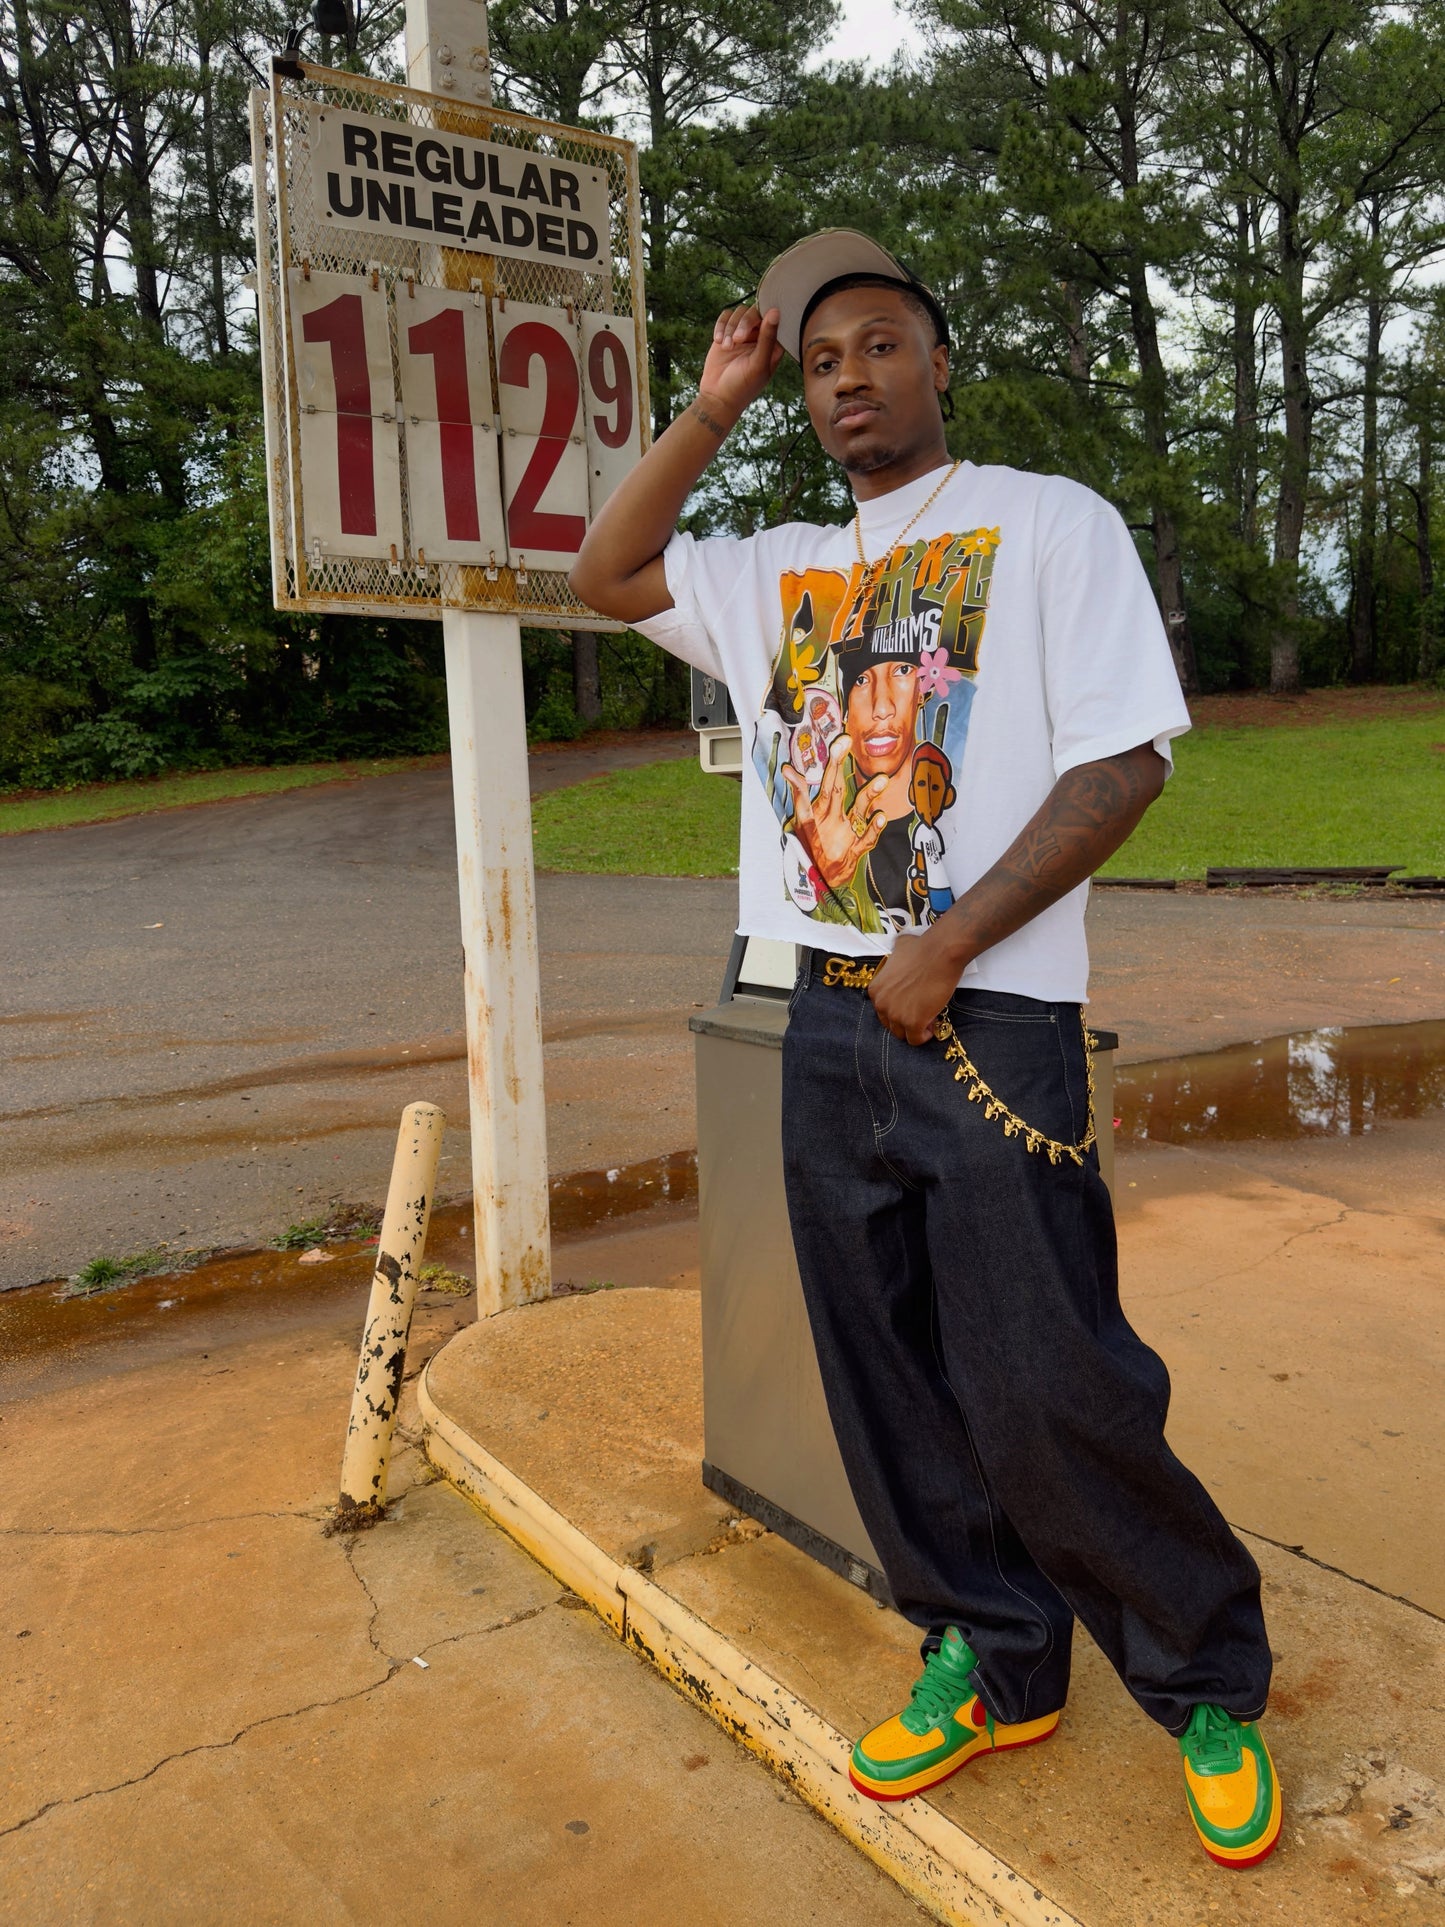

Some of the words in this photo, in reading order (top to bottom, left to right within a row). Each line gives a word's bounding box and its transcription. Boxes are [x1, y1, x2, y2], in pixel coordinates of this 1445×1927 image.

[342, 123, 581, 212] REGULAR
[327, 171, 600, 260] UNLEADED
[871, 608, 944, 654] WILLIAMS
